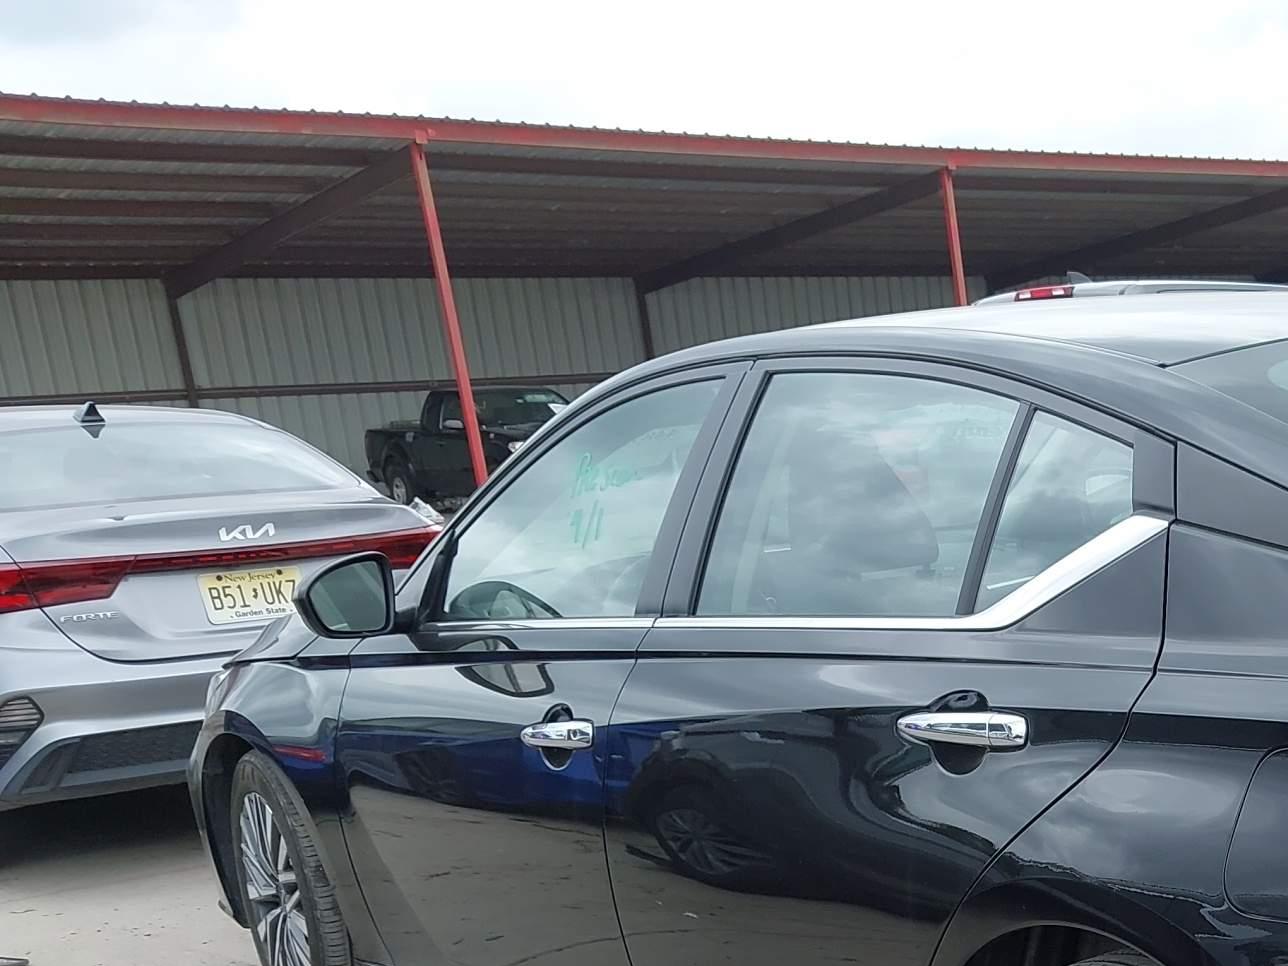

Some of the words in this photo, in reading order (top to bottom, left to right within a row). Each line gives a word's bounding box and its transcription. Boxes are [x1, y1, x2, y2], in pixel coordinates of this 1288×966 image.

[219, 522, 275, 541] KIA
[224, 573, 247, 583] New
[247, 571, 275, 582] Jersey
[208, 585, 250, 610] B51
[60, 611, 119, 622] FORTE
[234, 607, 264, 617] Garden
[265, 605, 287, 615] State
